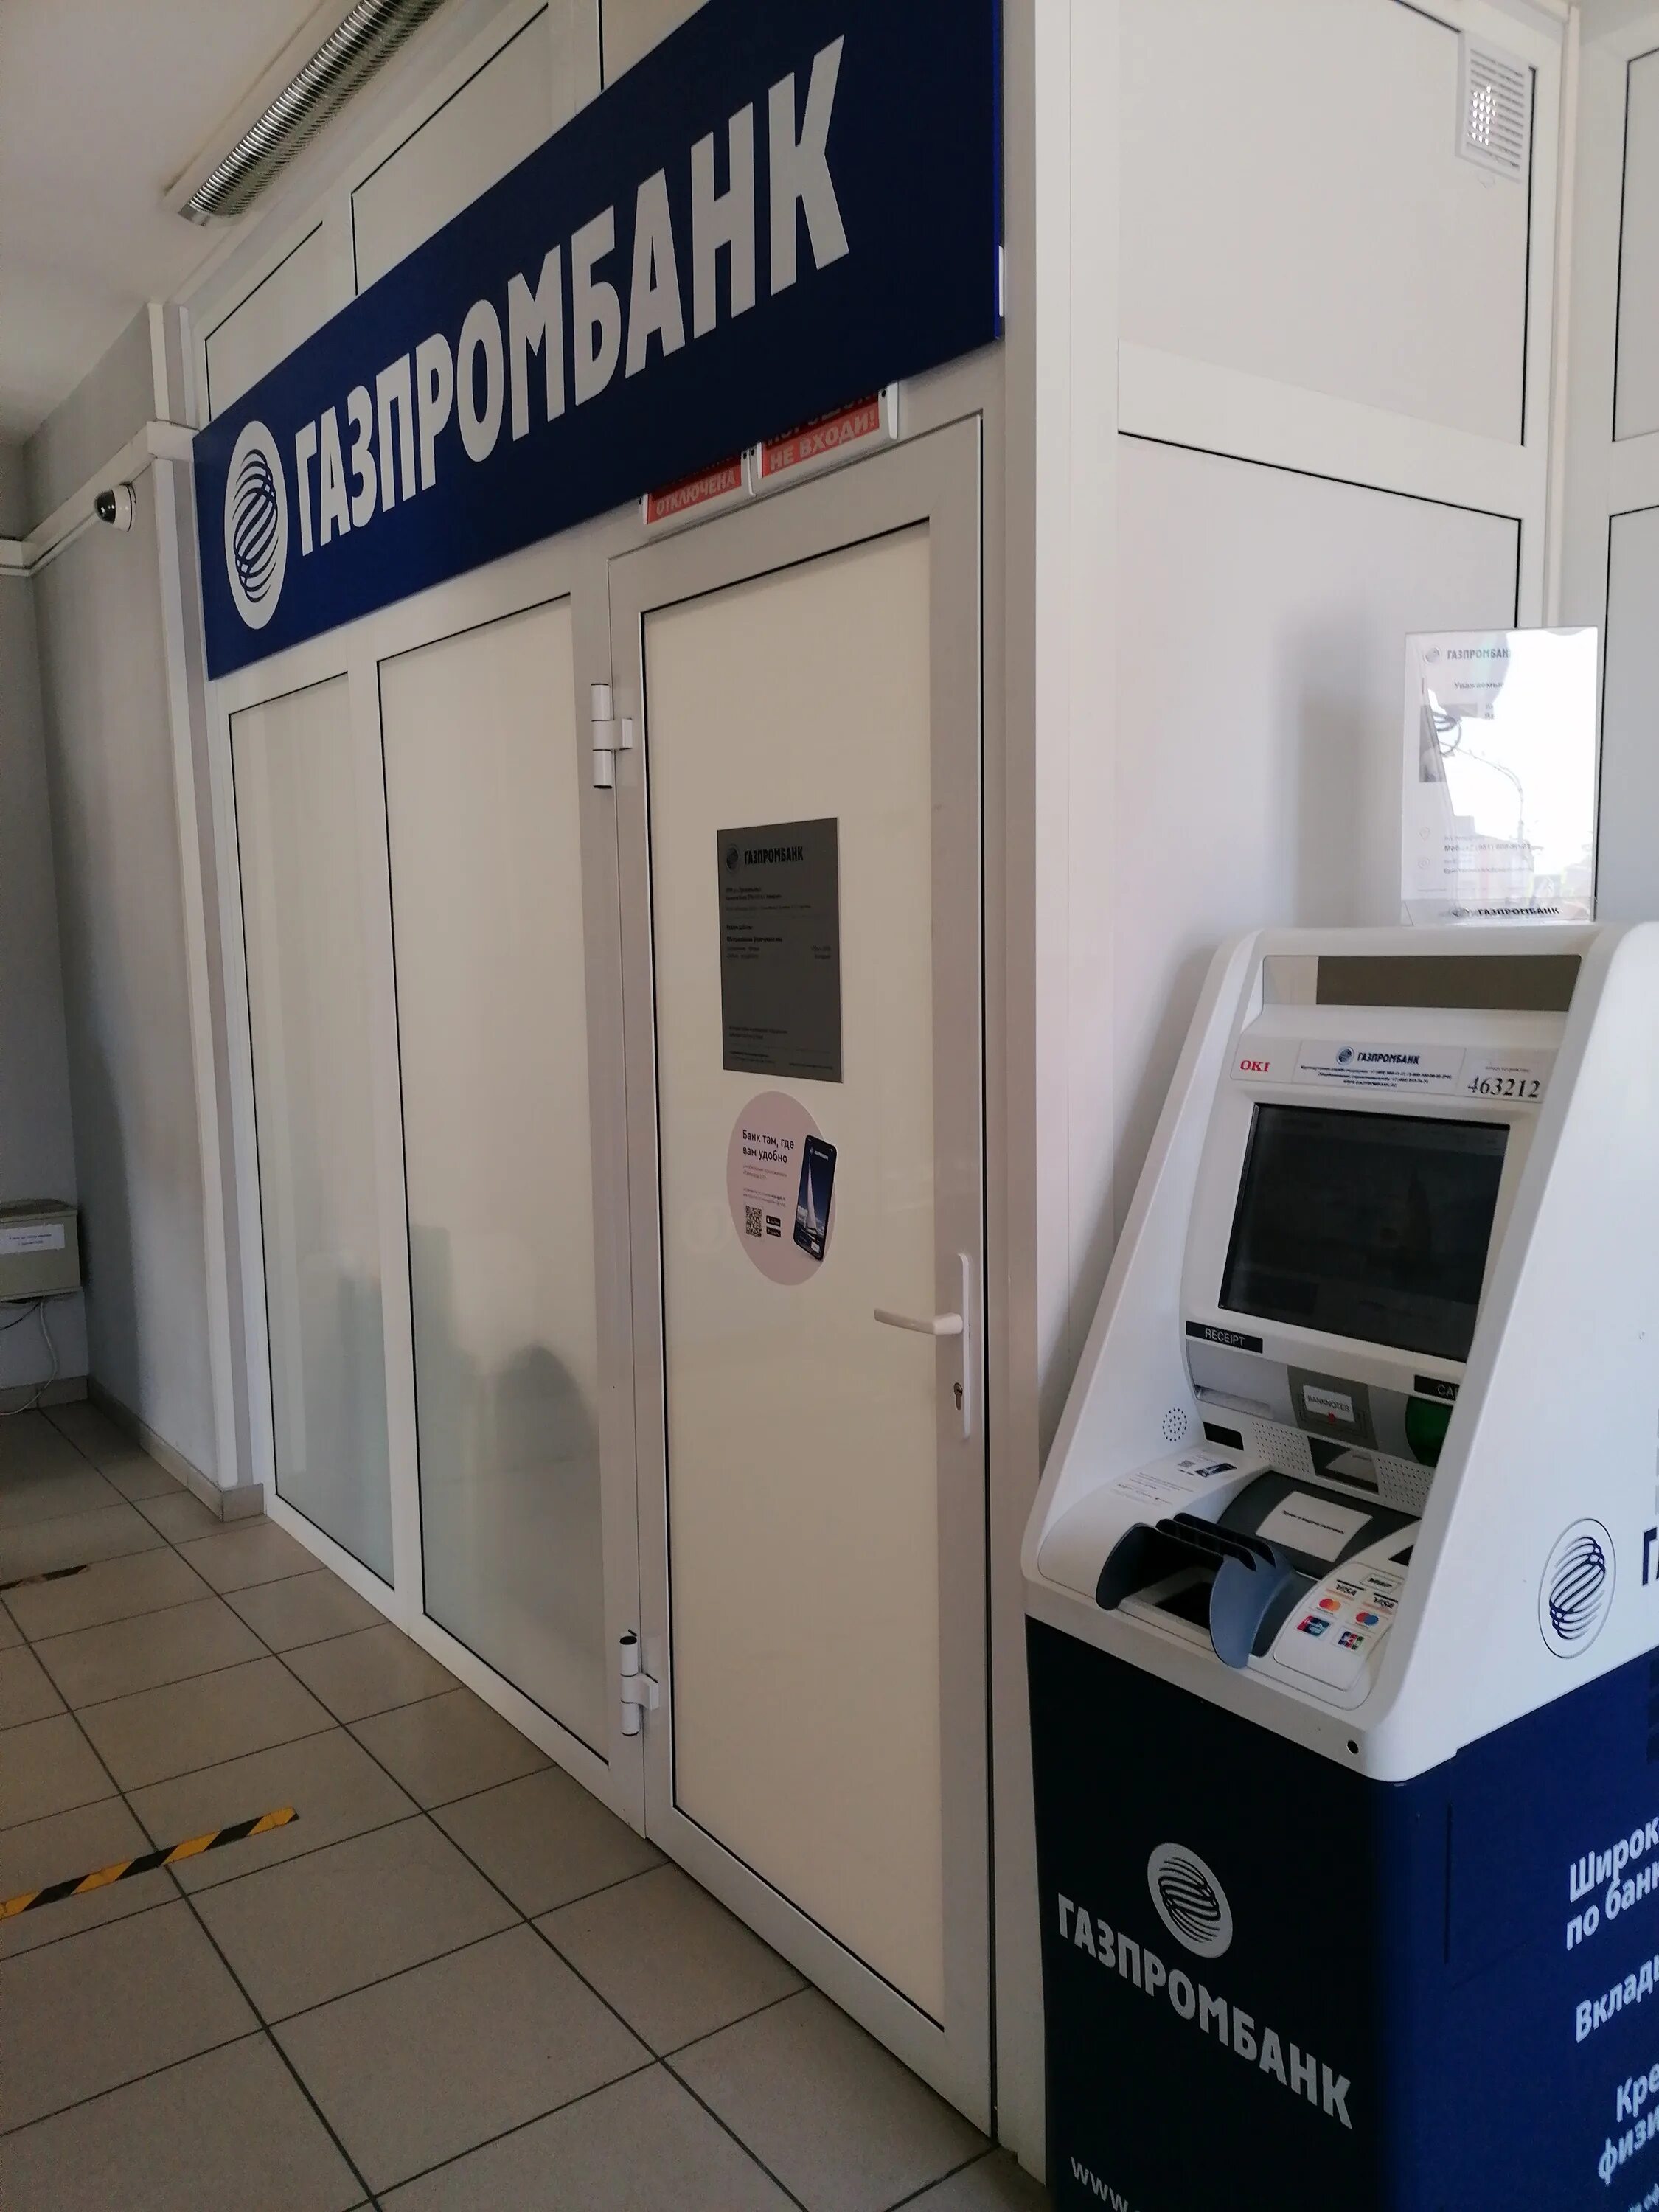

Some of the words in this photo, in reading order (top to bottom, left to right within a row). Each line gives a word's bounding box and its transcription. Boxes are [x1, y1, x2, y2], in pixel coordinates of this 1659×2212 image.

[294, 35, 850, 557] ГАЗПРОМБАНК
[770, 450, 794, 472] НЕ
[799, 408, 876, 456] ВХОДИ!
[656, 467, 736, 516] ОТКЛЮЧЕНА
[1447, 649, 1510, 661] ГАЗПРОМБАН
[744, 846, 804, 865] ГАЗПРОМБАНК
[1240, 1060, 1271, 1073] OKI
[1357, 1052, 1420, 1065] ГАЗПРОМБАНК
[1467, 1076, 1540, 1098] 463212
[742, 1129, 761, 1143] Банк
[762, 1135, 779, 1149] там,
[781, 1138, 795, 1150] где
[742, 1146, 757, 1157] вам
[759, 1150, 788, 1164] удобно
[1205, 1327, 1245, 1347] RECEIPT
[1437, 1383, 1457, 1399] CA
[1641, 1526, 1659, 1587] Г
[1336, 1583, 1357, 1596] VISA
[1374, 1596, 1395, 1609] VISA
[1566, 1905, 1600, 1951] по
[1057, 1892, 1353, 2130] ГАЗПРОМБАНК
